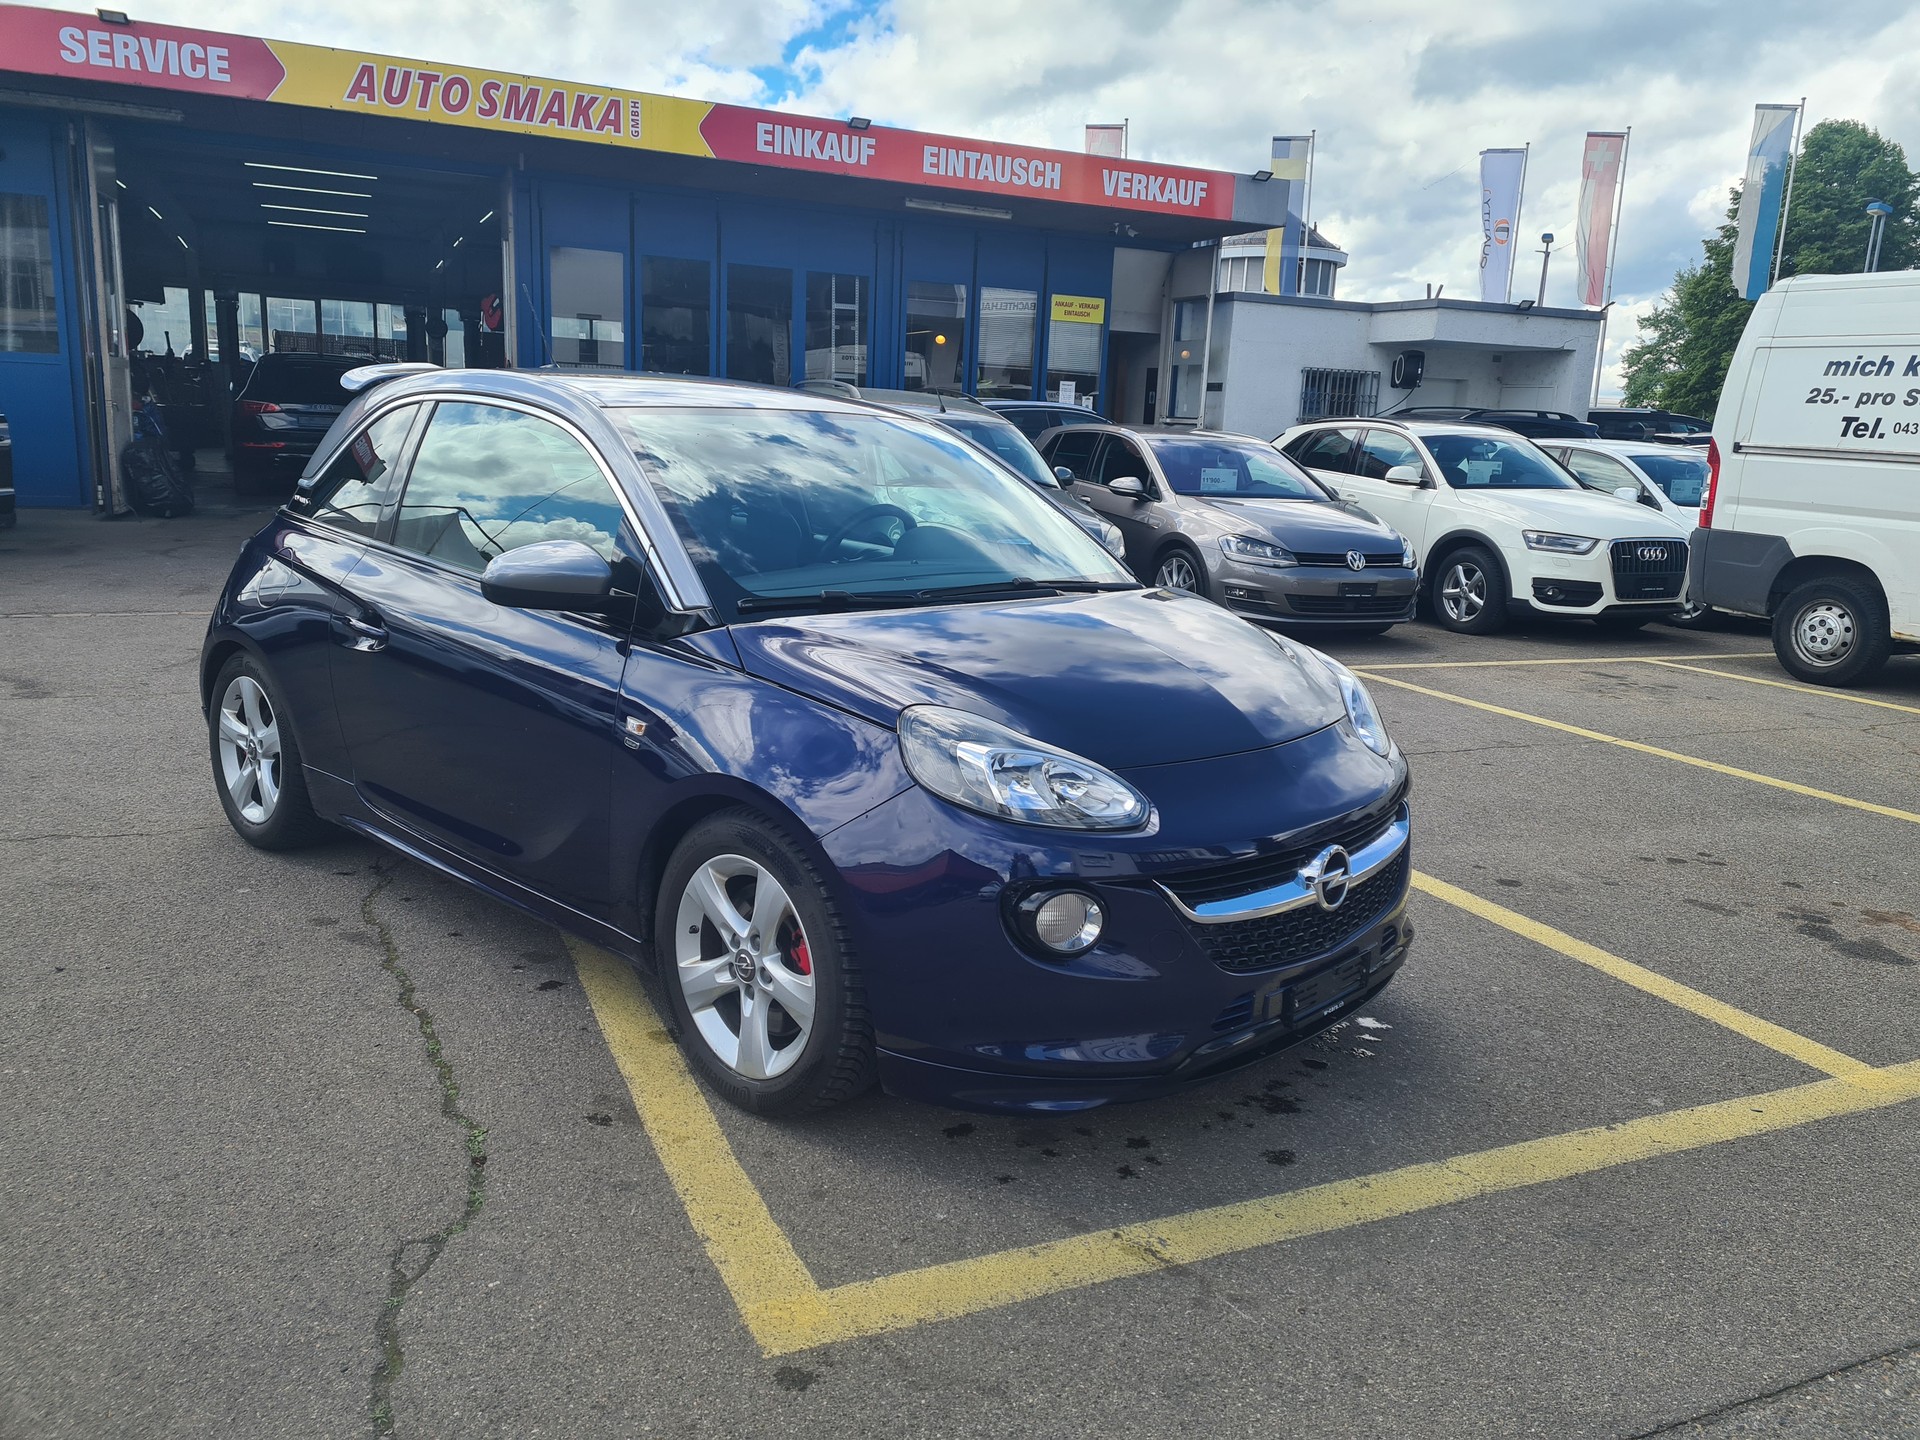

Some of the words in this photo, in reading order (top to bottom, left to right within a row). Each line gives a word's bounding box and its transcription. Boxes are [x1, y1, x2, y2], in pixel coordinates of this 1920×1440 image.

[58, 26, 231, 83] SERVICE
[343, 61, 472, 115] AUTO
[475, 79, 624, 137] SMAKA
[629, 99, 641, 139] GMBH
[755, 121, 877, 166] EINKAUF
[922, 145, 1062, 190] EINTAUSCH
[1101, 168, 1209, 207] VERKAUF
[1054, 300, 1074, 308] ANKAUF
[1078, 302, 1100, 310] VERKAUF
[1063, 309, 1091, 318] EINTAUSCH
[1822, 354, 1895, 377] mich
[1804, 387, 1850, 405] 25.-
[1854, 391, 1896, 409] pro
[1902, 387, 1920, 407] S
[1840, 415, 1886, 440] Tel.
[1892, 421, 1919, 435] 043
